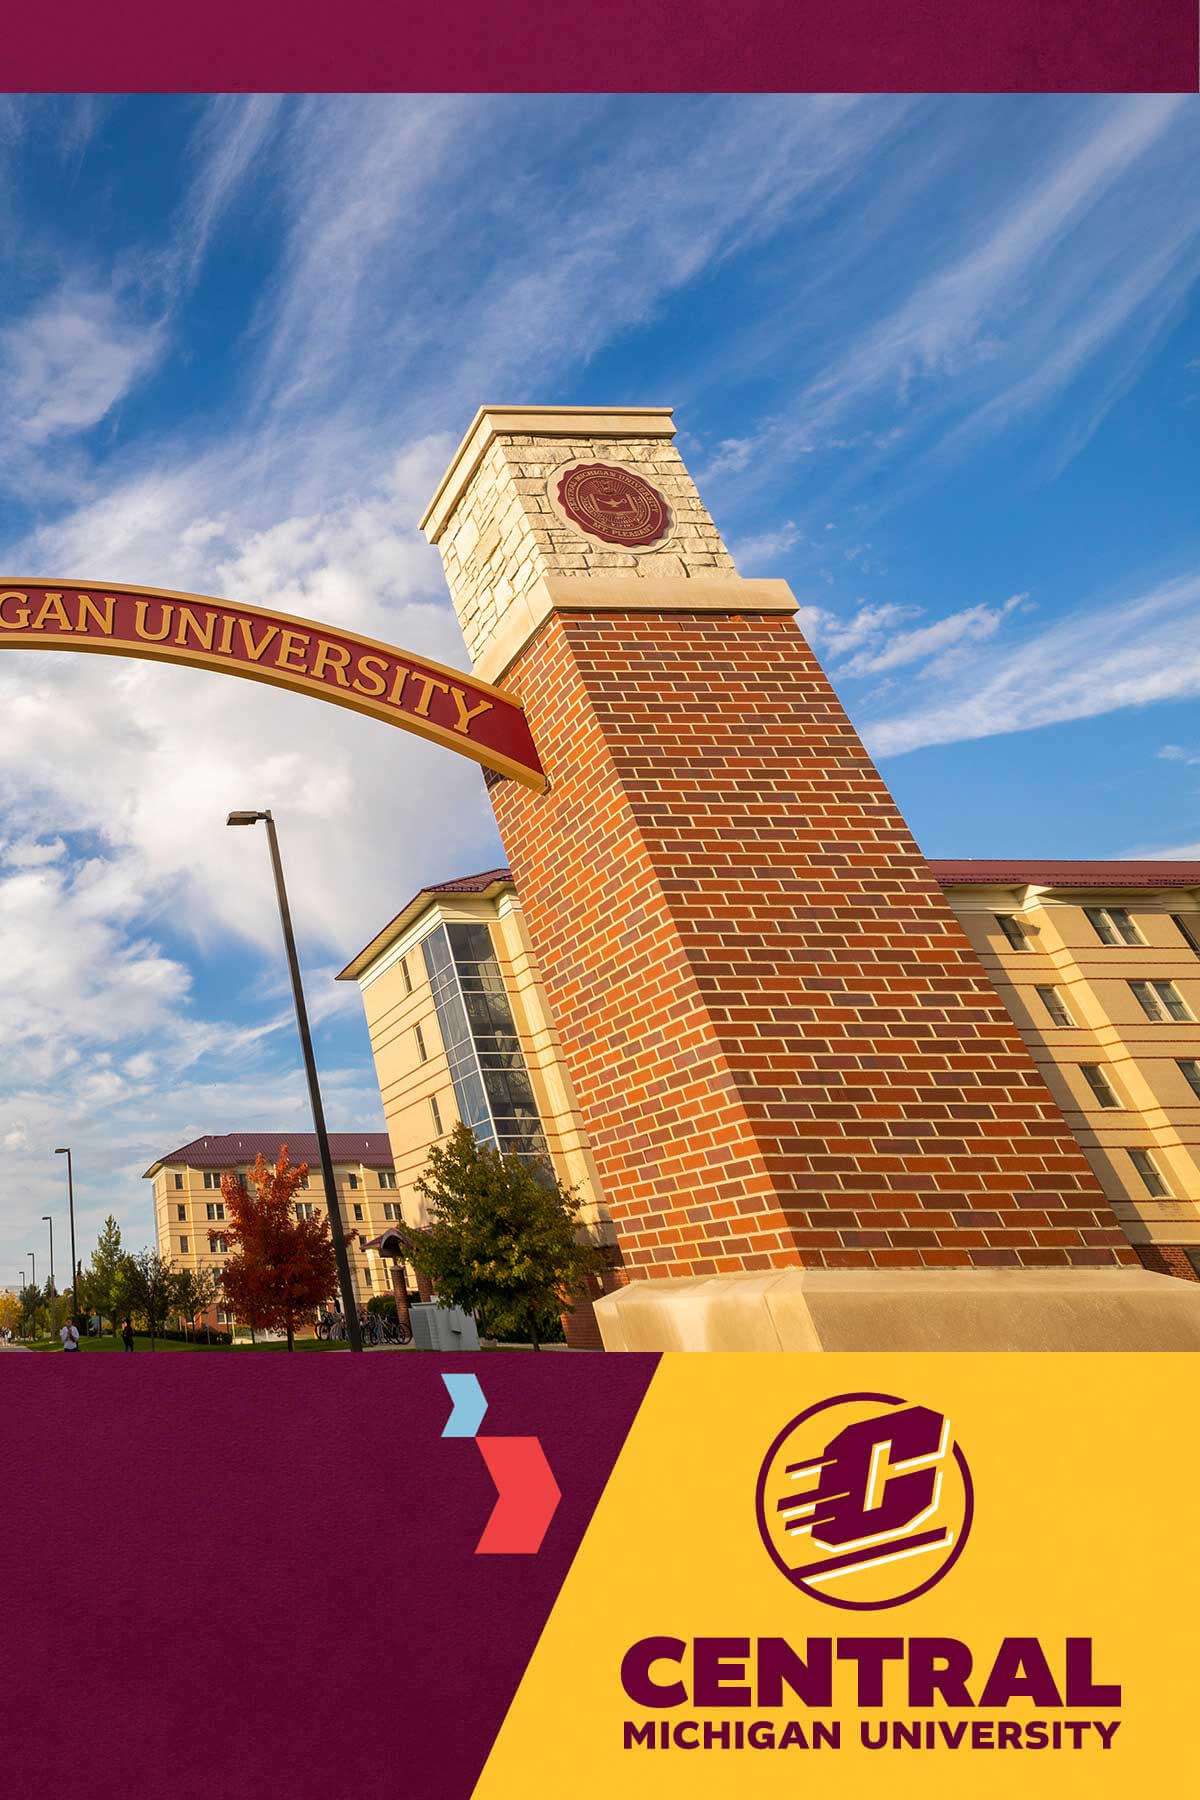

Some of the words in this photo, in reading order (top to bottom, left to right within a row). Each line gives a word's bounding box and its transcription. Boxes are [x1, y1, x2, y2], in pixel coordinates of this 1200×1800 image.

[618, 474, 659, 513] UNIVERSITY
[612, 524, 654, 537] PLEASANT
[134, 601, 493, 734] UNIVERSITY
